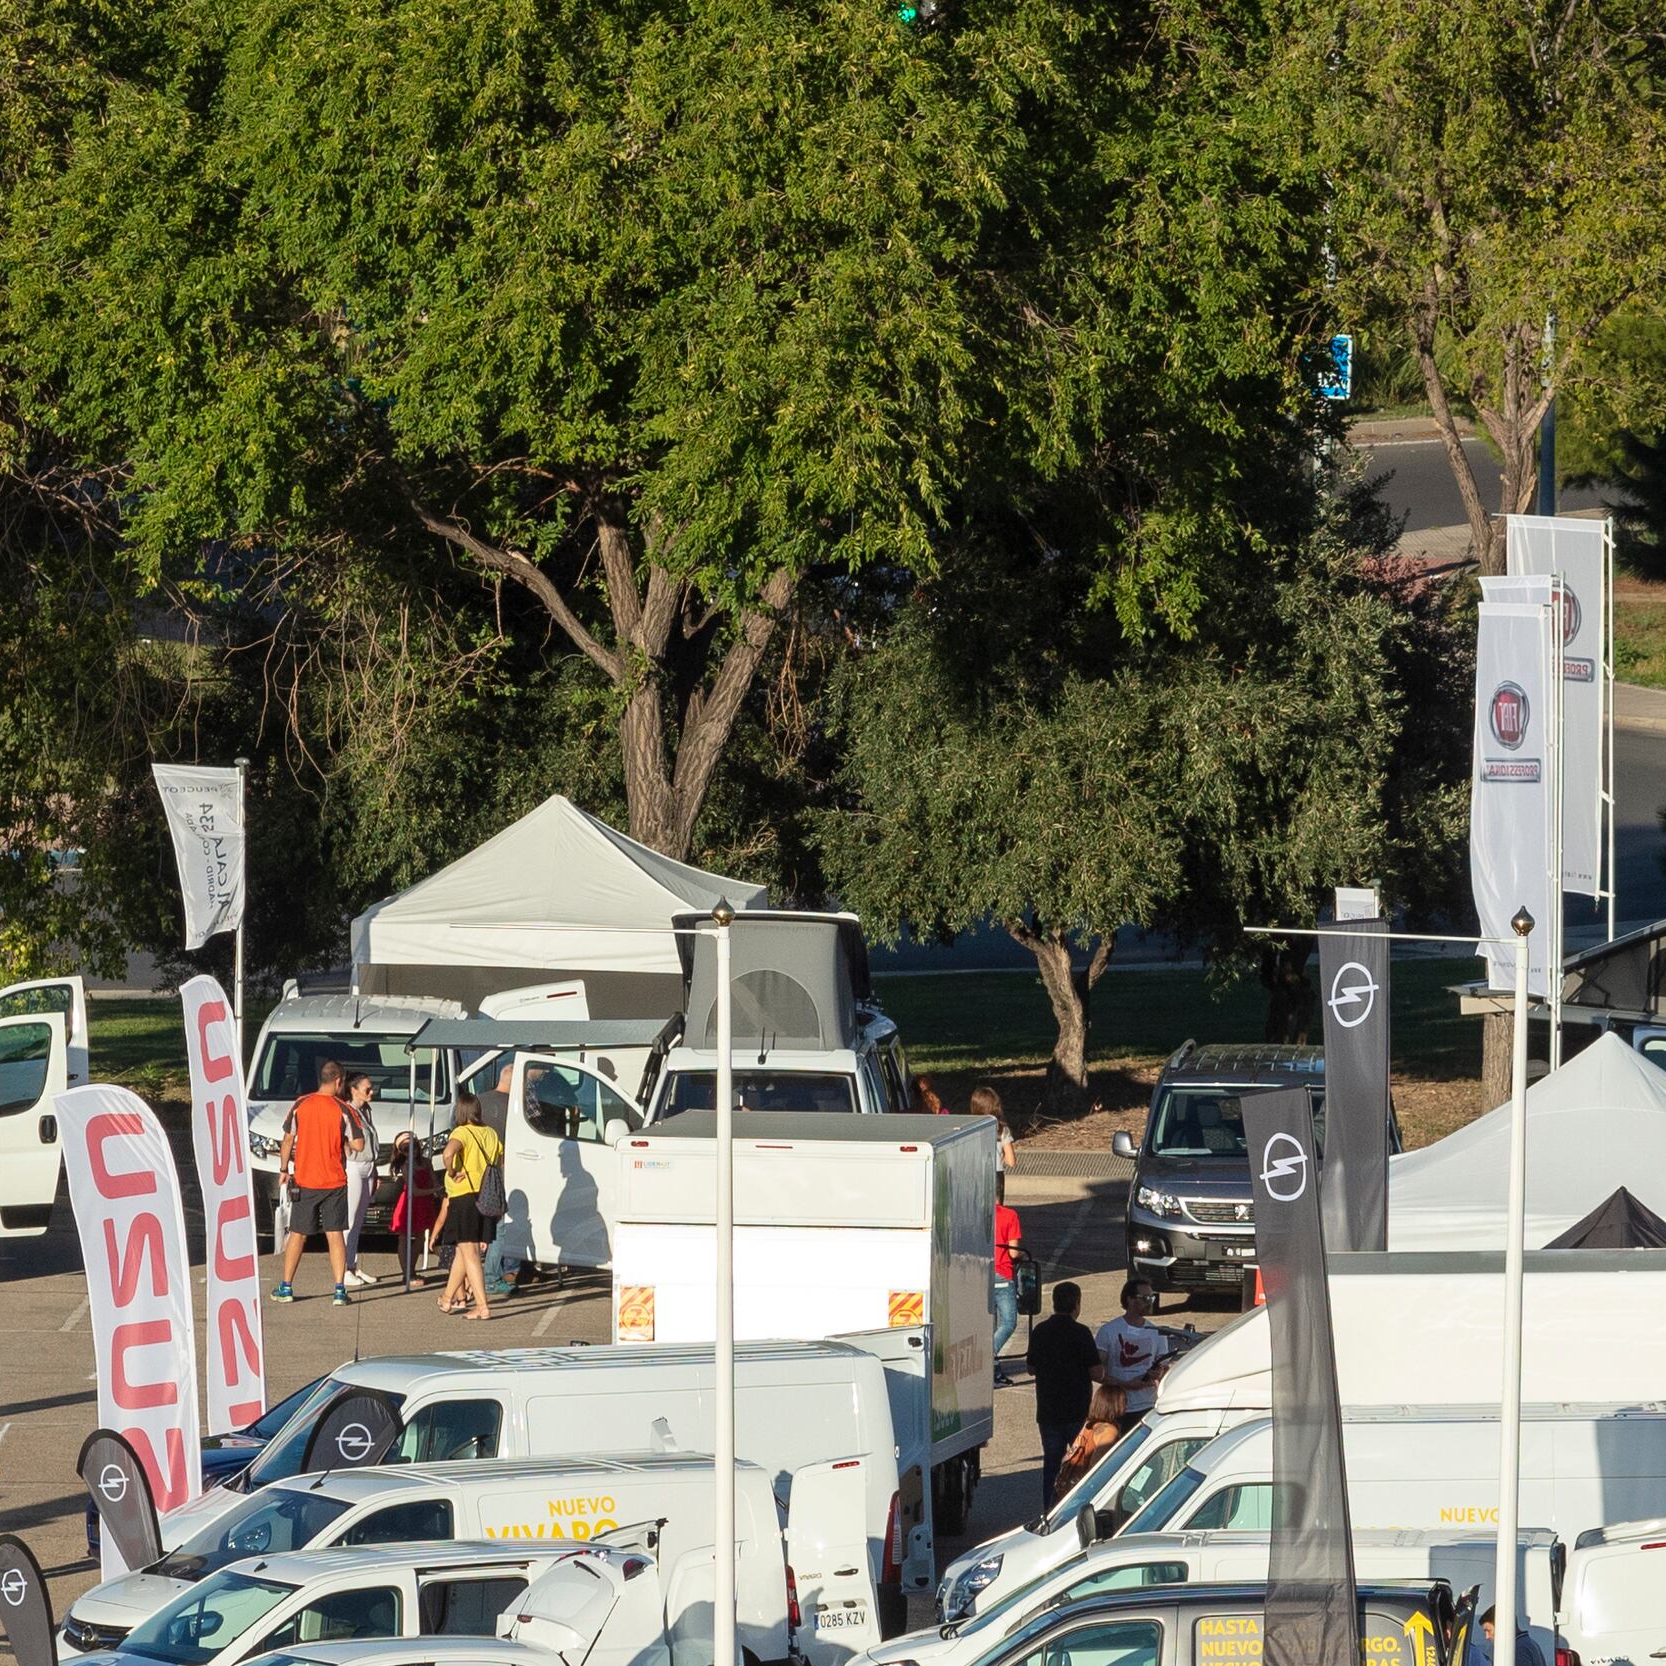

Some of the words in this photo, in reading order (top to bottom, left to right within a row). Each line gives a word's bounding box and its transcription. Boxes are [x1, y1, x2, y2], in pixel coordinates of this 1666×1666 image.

[548, 1496, 616, 1518] NUEVO
[820, 1613, 844, 1628] 0285
[846, 1611, 866, 1626] KZV
[1200, 1619, 1259, 1636] HASTA
[1200, 1640, 1263, 1657] NUEVO
